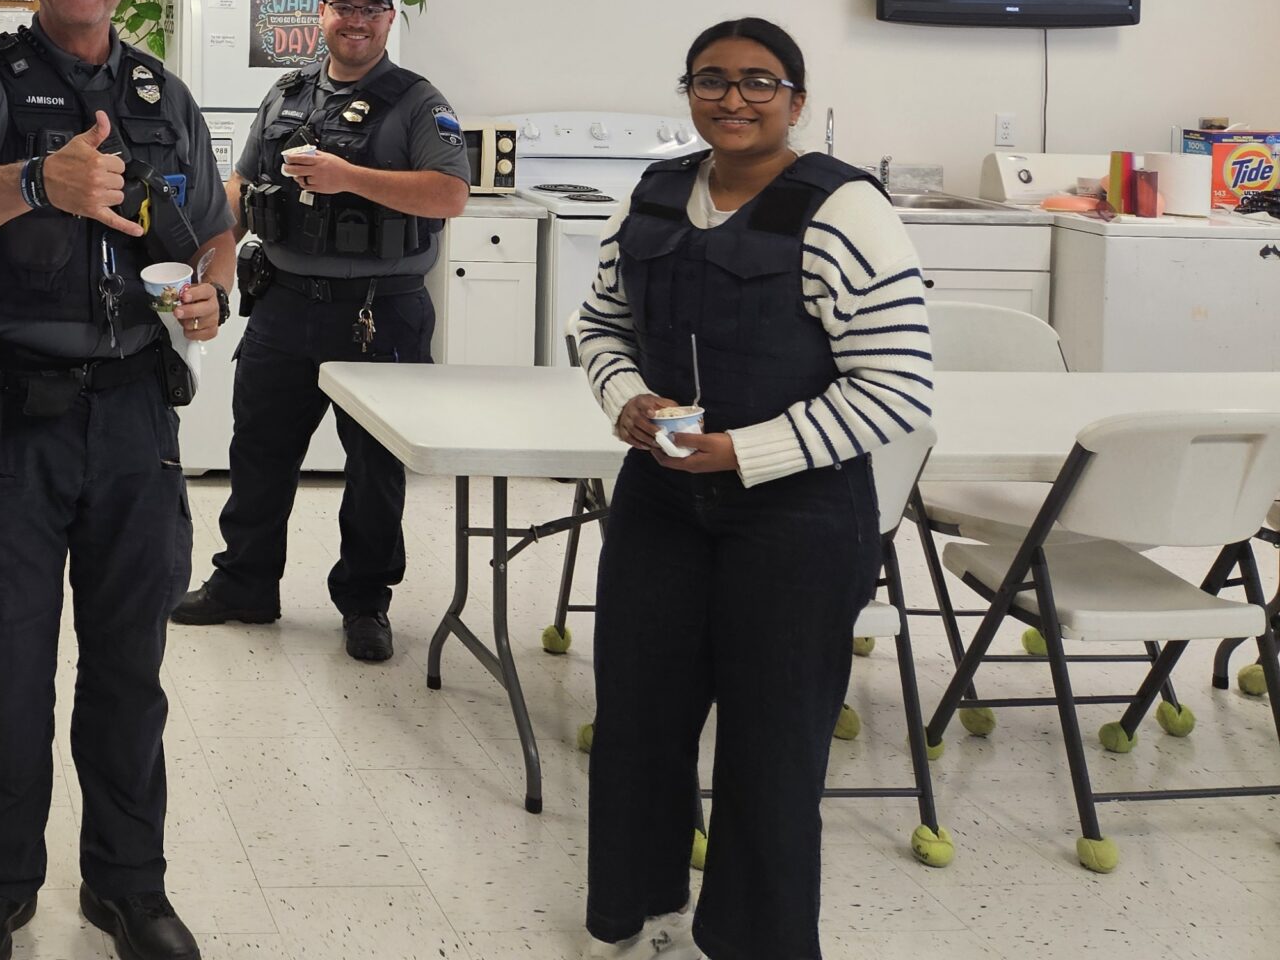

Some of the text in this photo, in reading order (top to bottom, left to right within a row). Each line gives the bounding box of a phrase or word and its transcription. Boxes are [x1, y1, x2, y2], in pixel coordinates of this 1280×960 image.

[270, 16, 321, 24] WONDERFU
[273, 26, 319, 55] DAY
[25, 95, 65, 106] JAMISON
[1232, 158, 1274, 189] Tide
